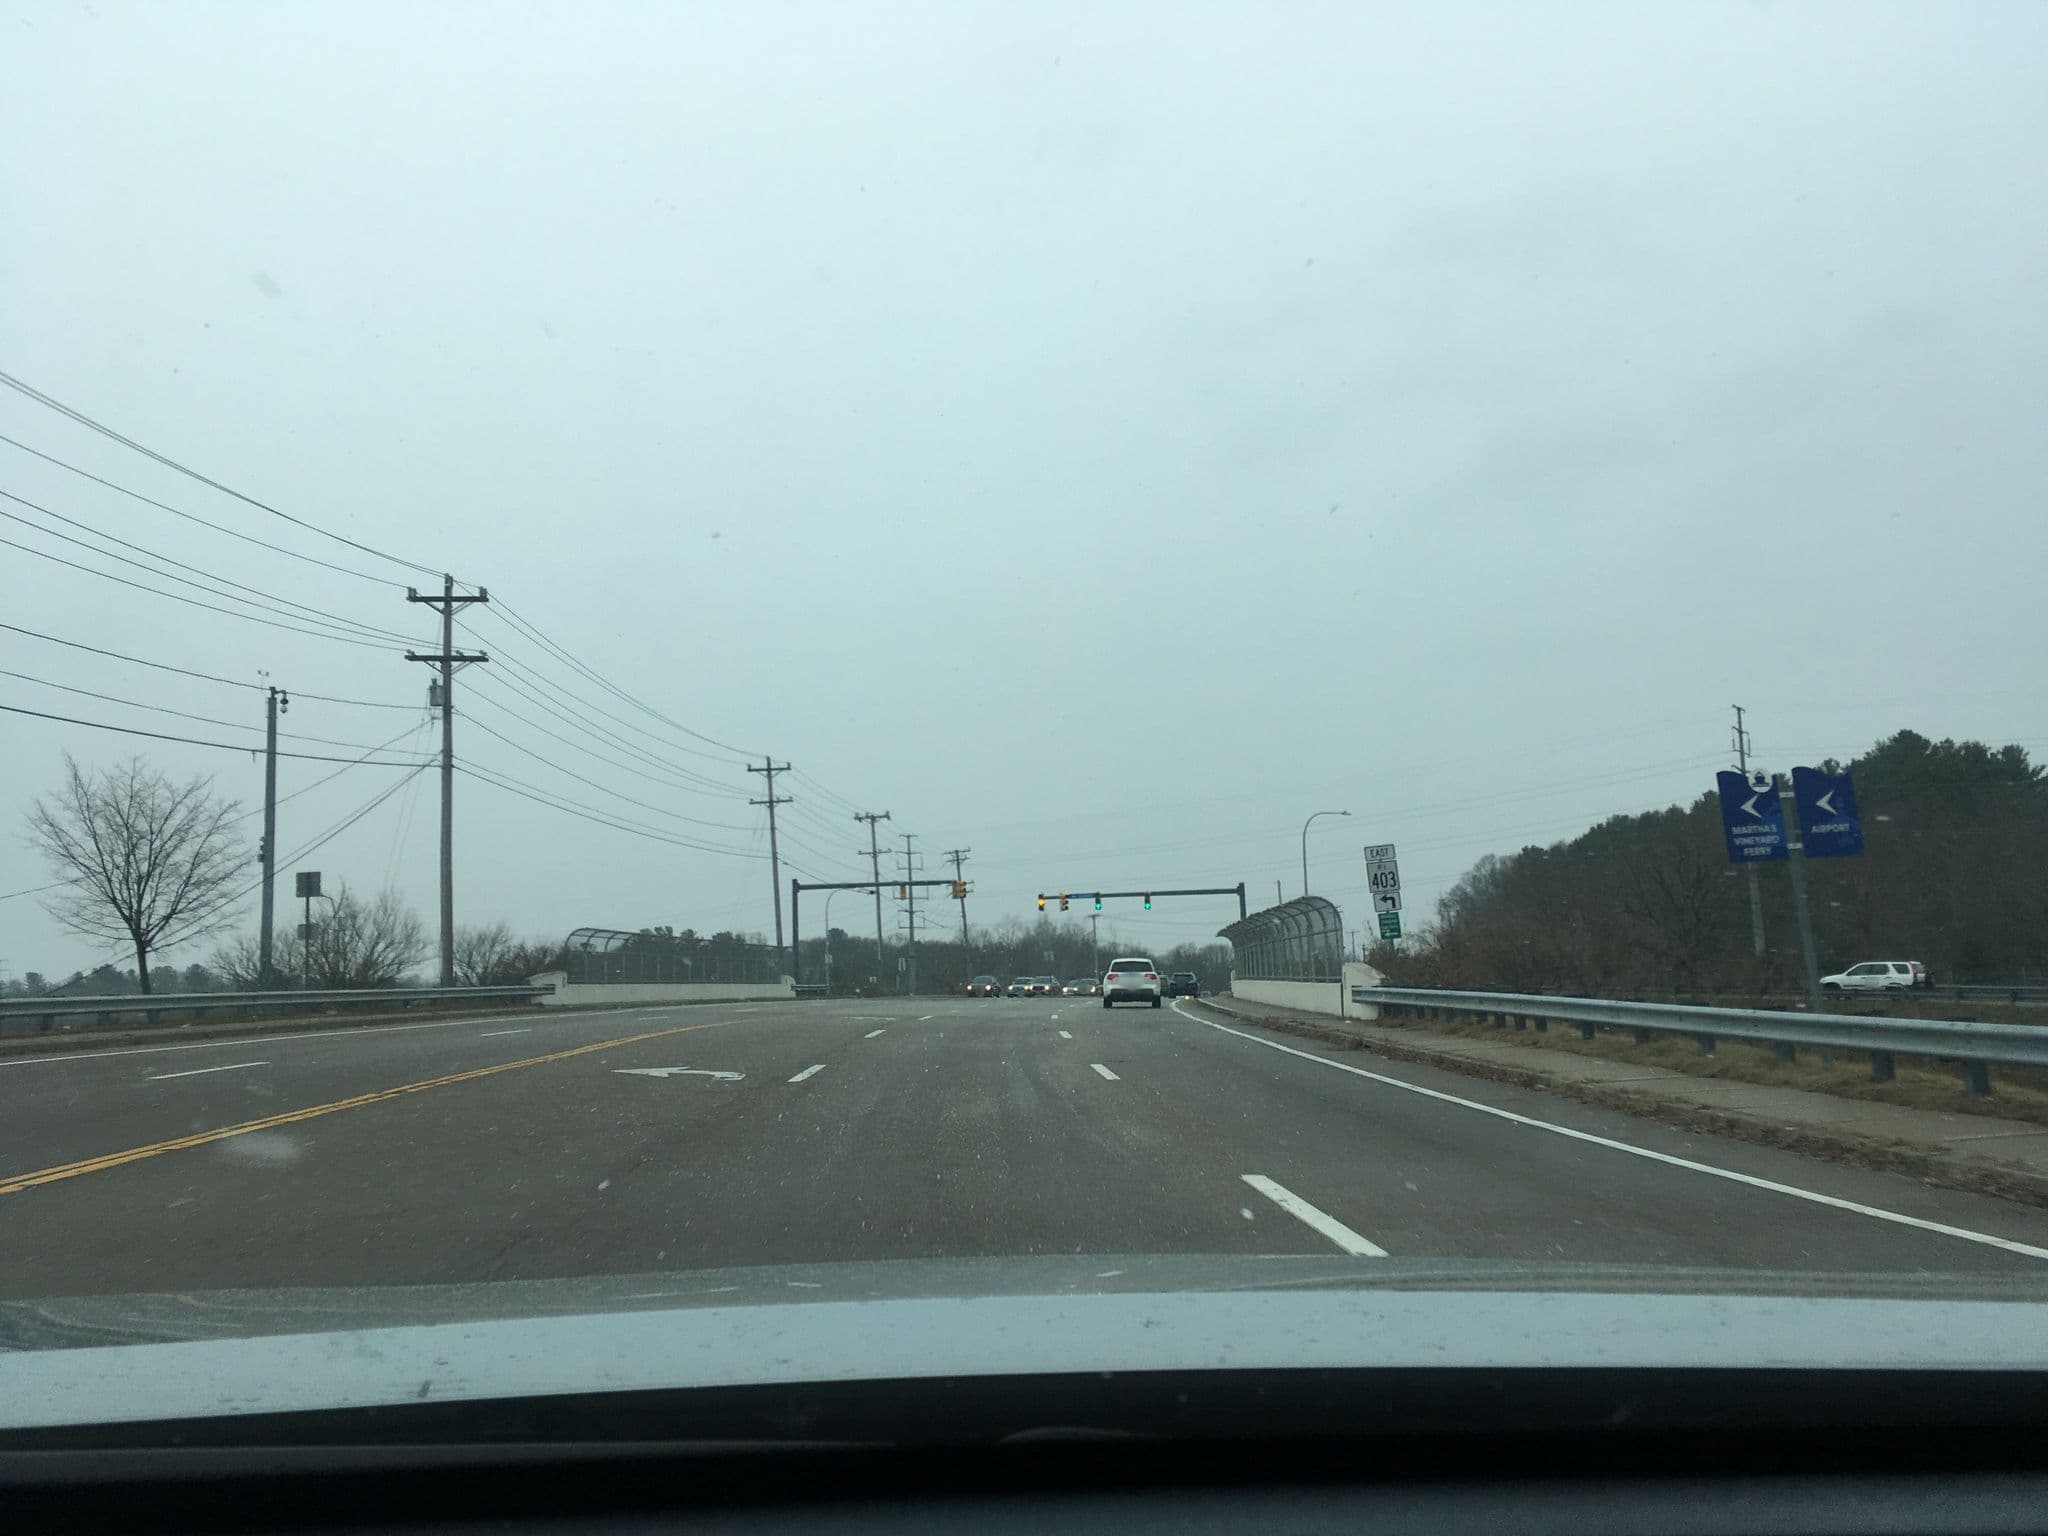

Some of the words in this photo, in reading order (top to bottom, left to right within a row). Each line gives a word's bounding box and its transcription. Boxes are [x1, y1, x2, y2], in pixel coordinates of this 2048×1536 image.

[1811, 823, 1850, 832] AIRPORT
[1733, 835, 1780, 845] VINEYARD
[1370, 848, 1388, 858] EAST
[1743, 847, 1771, 856] FERRY
[1372, 871, 1396, 889] 403
